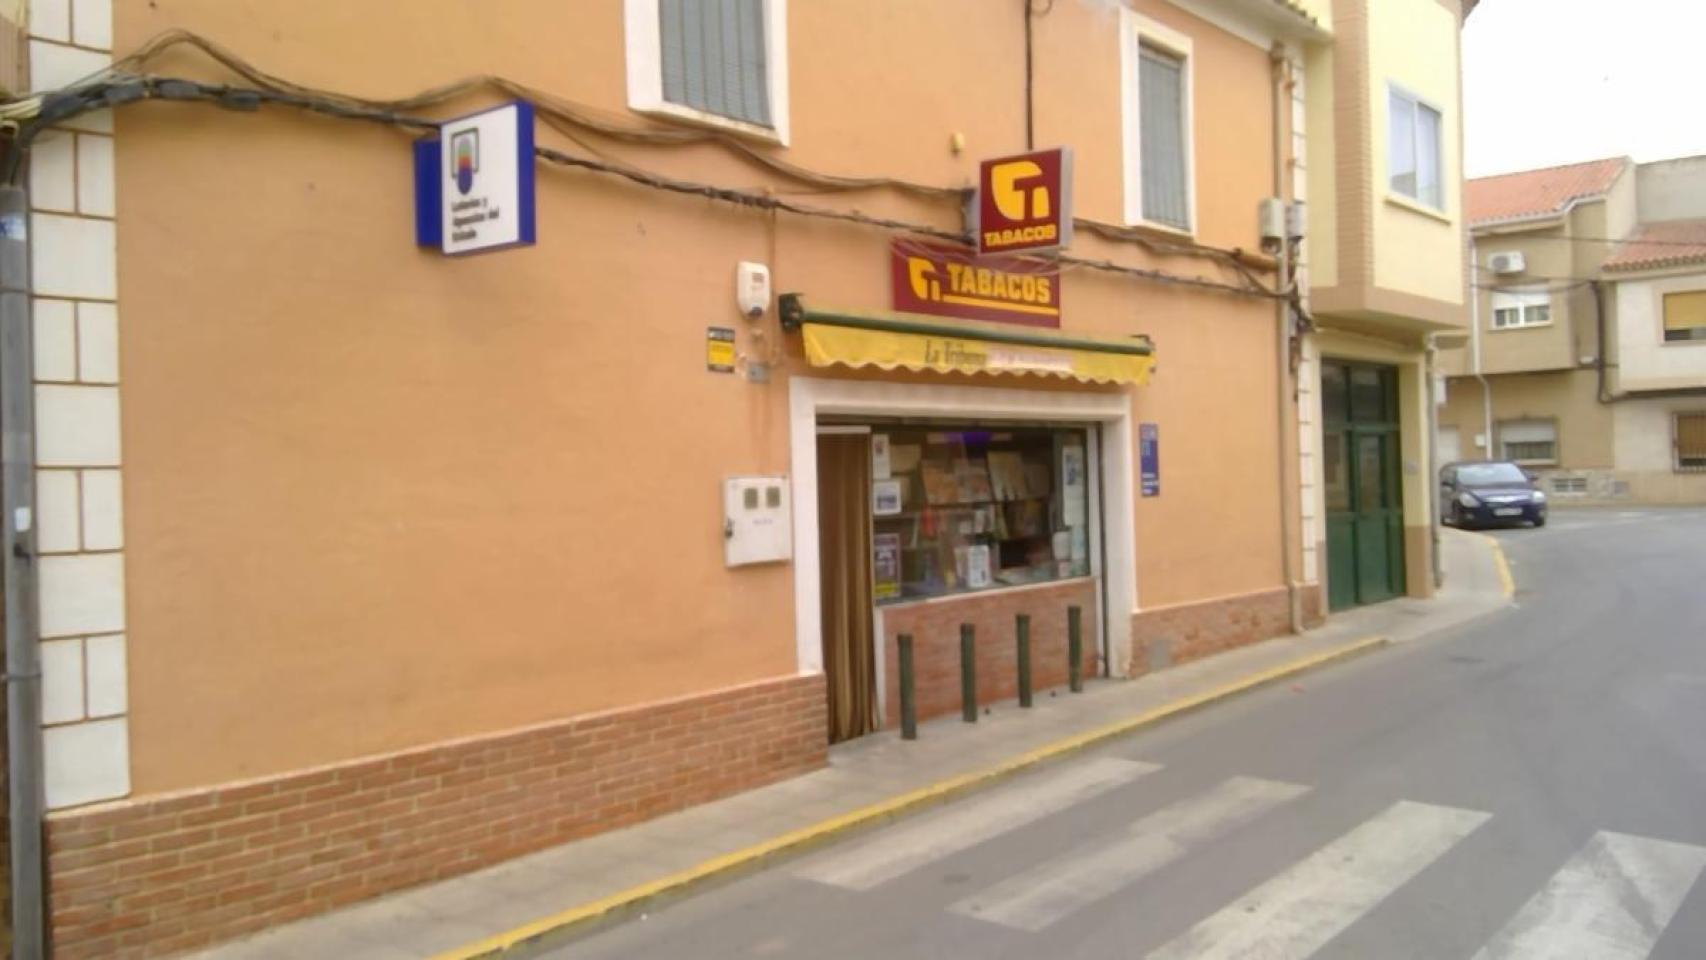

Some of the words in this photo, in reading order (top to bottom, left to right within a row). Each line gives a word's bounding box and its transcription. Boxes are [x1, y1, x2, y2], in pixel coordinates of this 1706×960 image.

[984, 224, 1057, 247] TABACOS
[947, 262, 1050, 303] TABACOS
[925, 340, 939, 363] La
